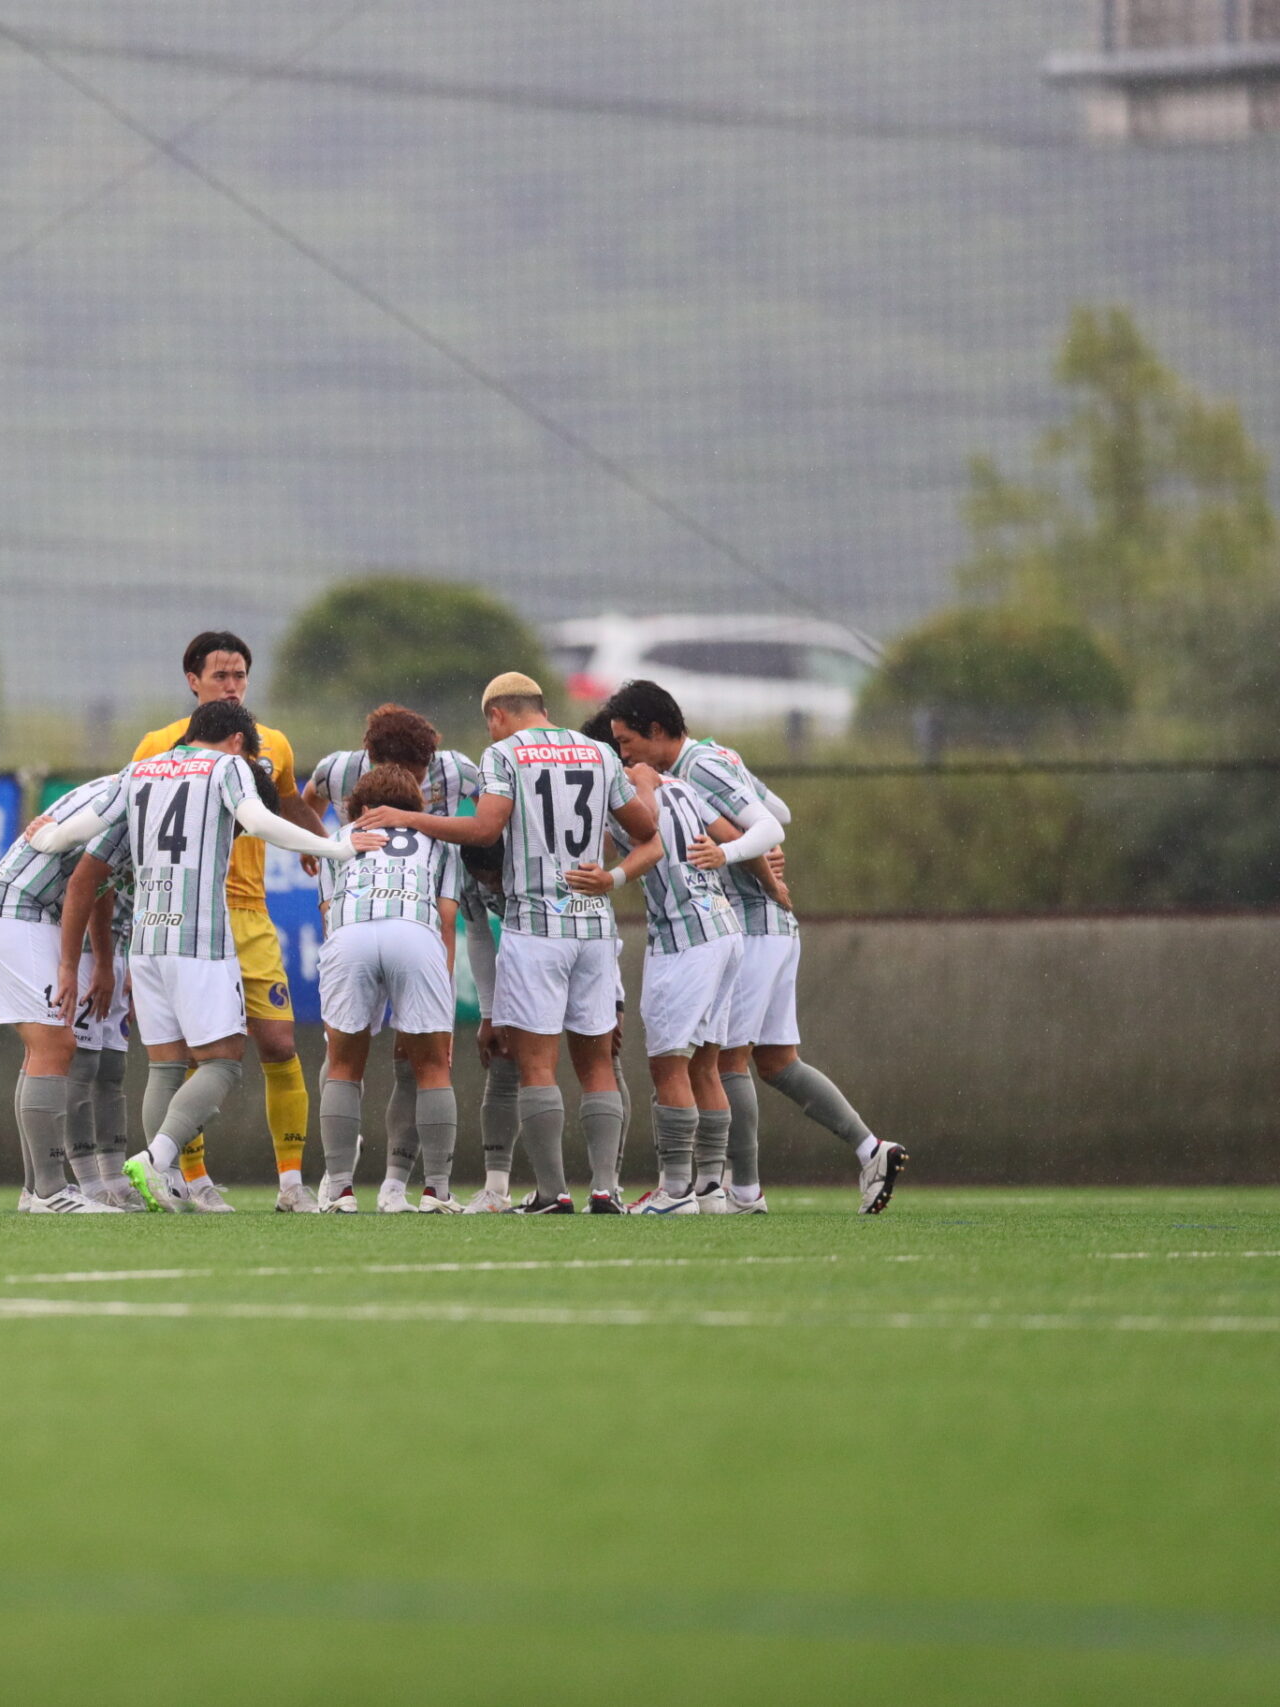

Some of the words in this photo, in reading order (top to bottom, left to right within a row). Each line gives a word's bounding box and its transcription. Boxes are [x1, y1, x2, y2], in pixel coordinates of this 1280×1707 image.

[516, 747, 600, 763] FRONTIER
[134, 759, 212, 777] FRONTIER
[534, 768, 595, 858] 13
[135, 781, 191, 866] 14
[347, 865, 417, 878] KAZUYA
[140, 880, 173, 892] YUTO
